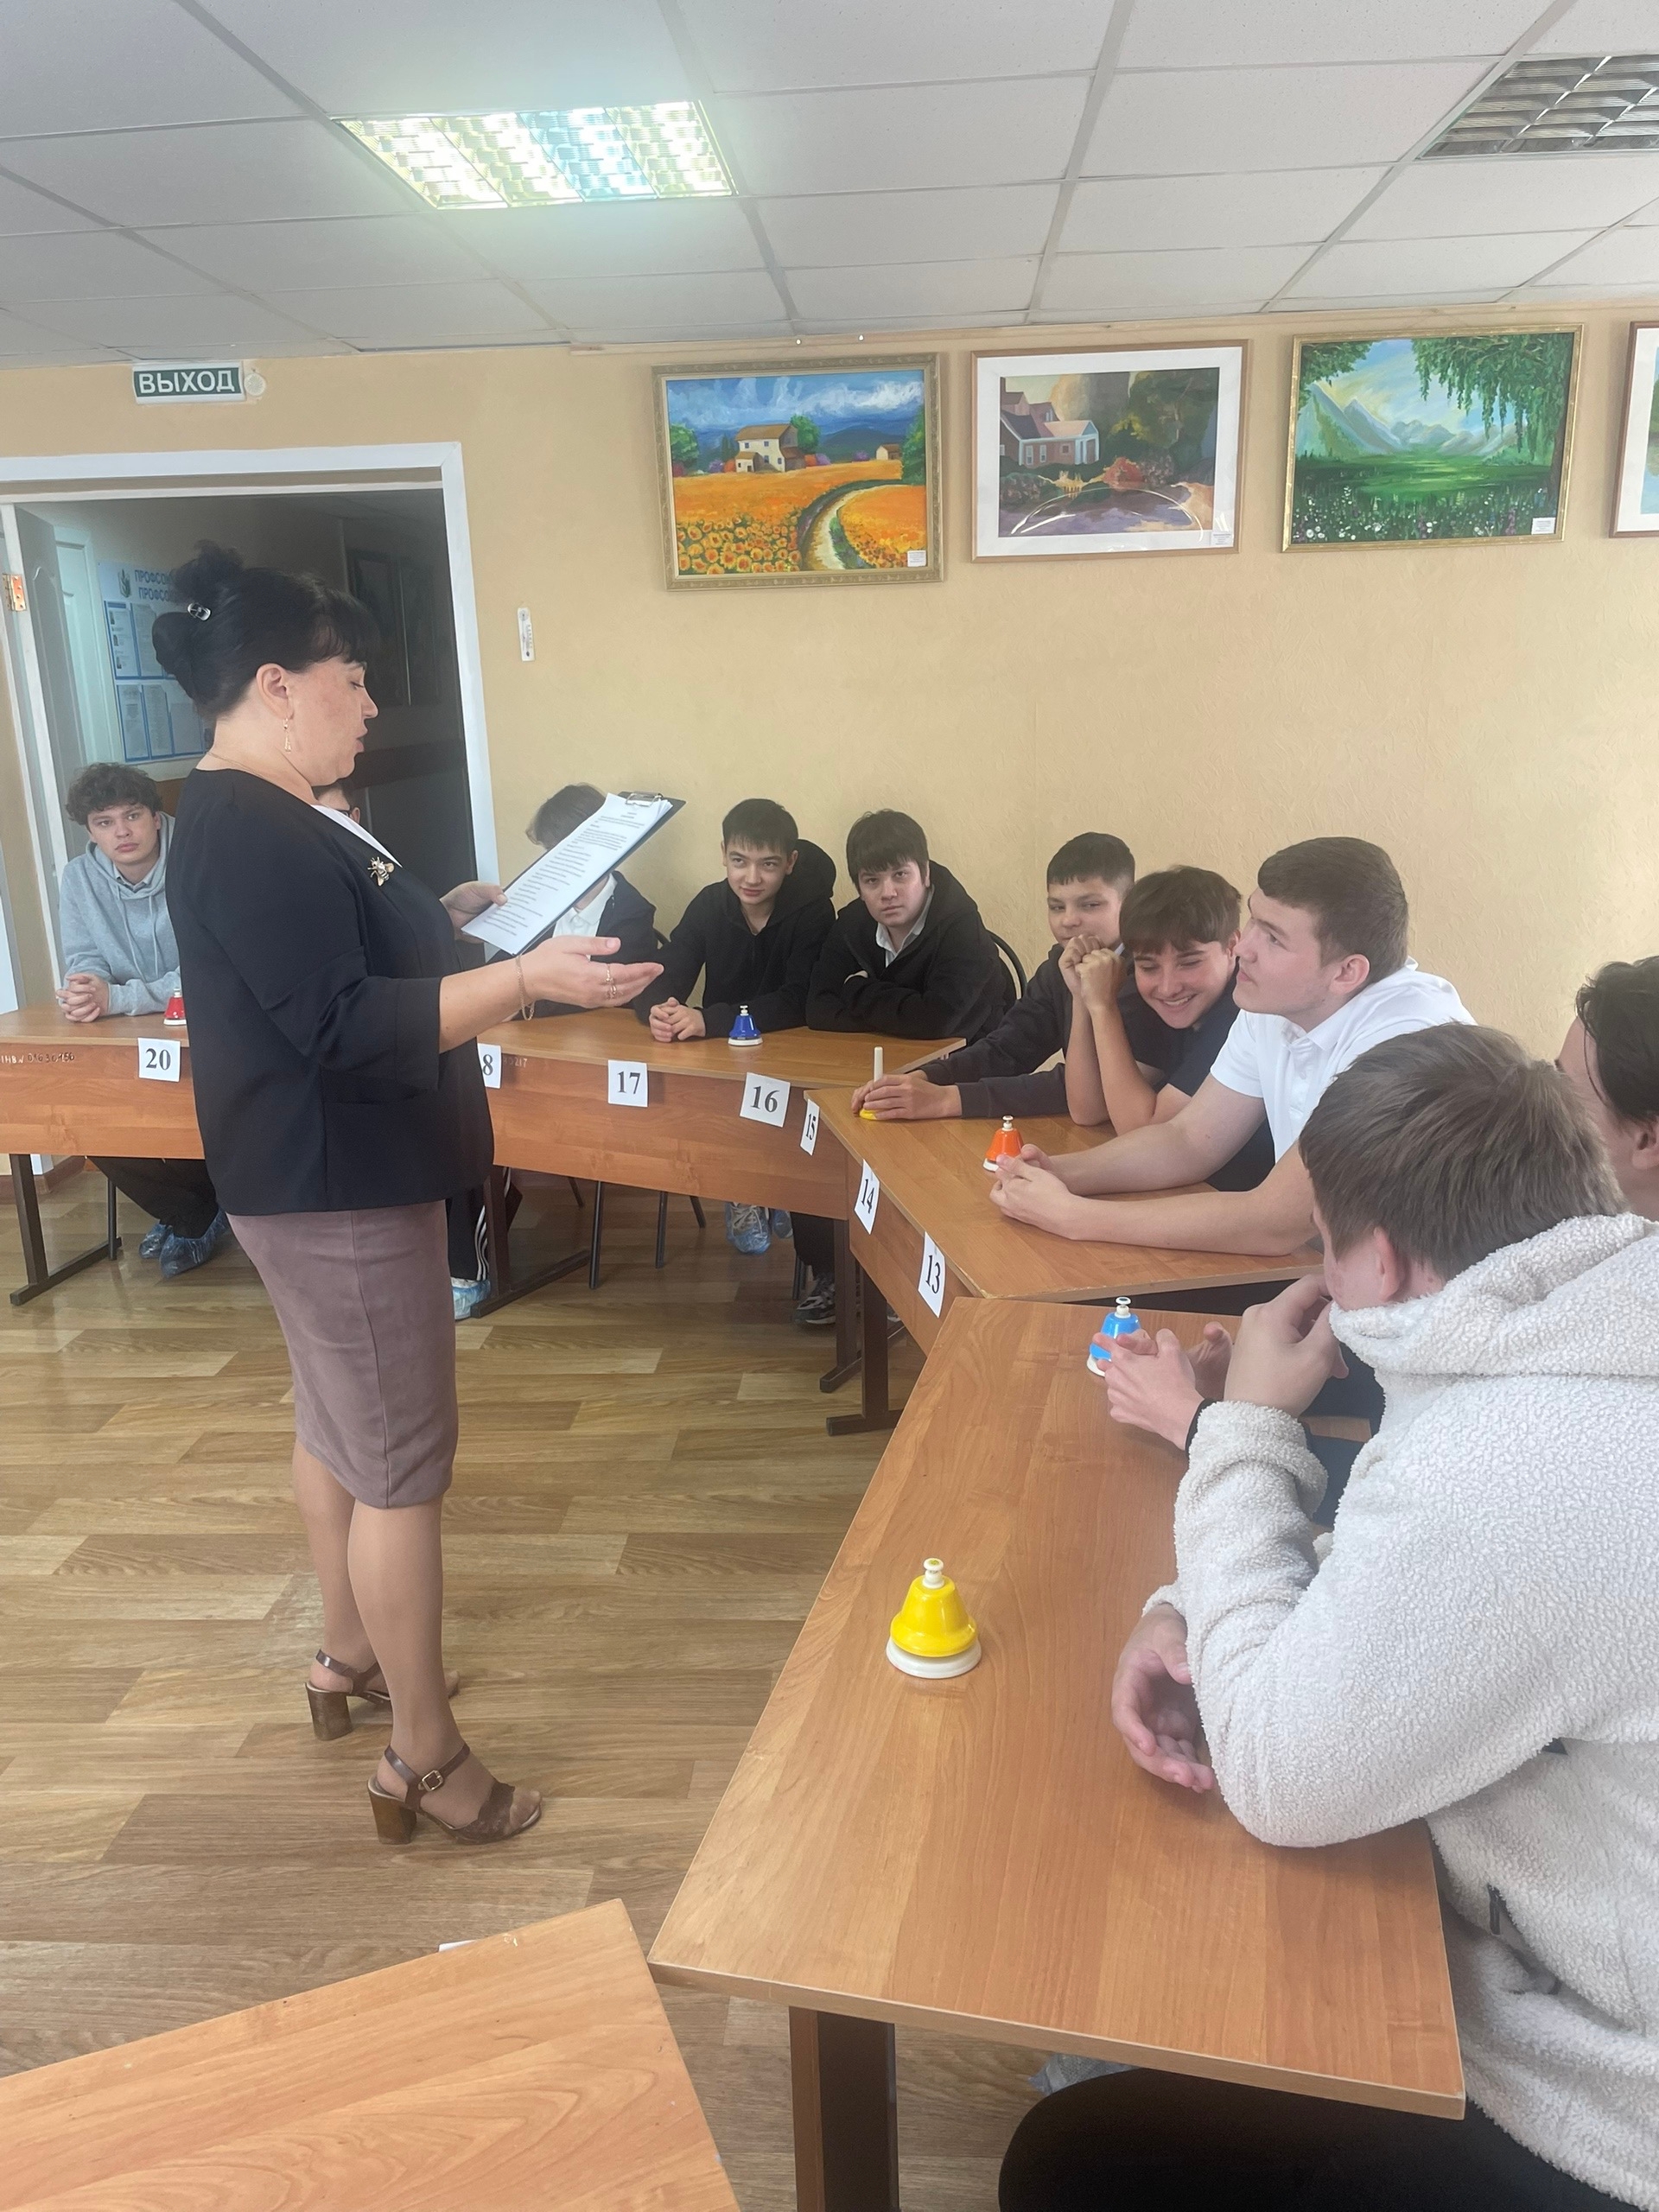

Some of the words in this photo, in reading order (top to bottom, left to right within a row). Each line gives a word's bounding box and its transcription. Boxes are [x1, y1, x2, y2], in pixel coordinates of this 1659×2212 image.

[138, 371, 235, 394] ВЫХОД
[135, 569, 171, 585] ПРОФСО
[138, 587, 171, 602] ПРОФСО
[145, 1048, 172, 1071] 20
[482, 1054, 493, 1076] 8
[617, 1071, 641, 1095] 17
[751, 1085, 780, 1113] 16
[805, 1113, 817, 1141] 15
[861, 1179, 874, 1214] 14
[925, 1255, 941, 1294] 13
